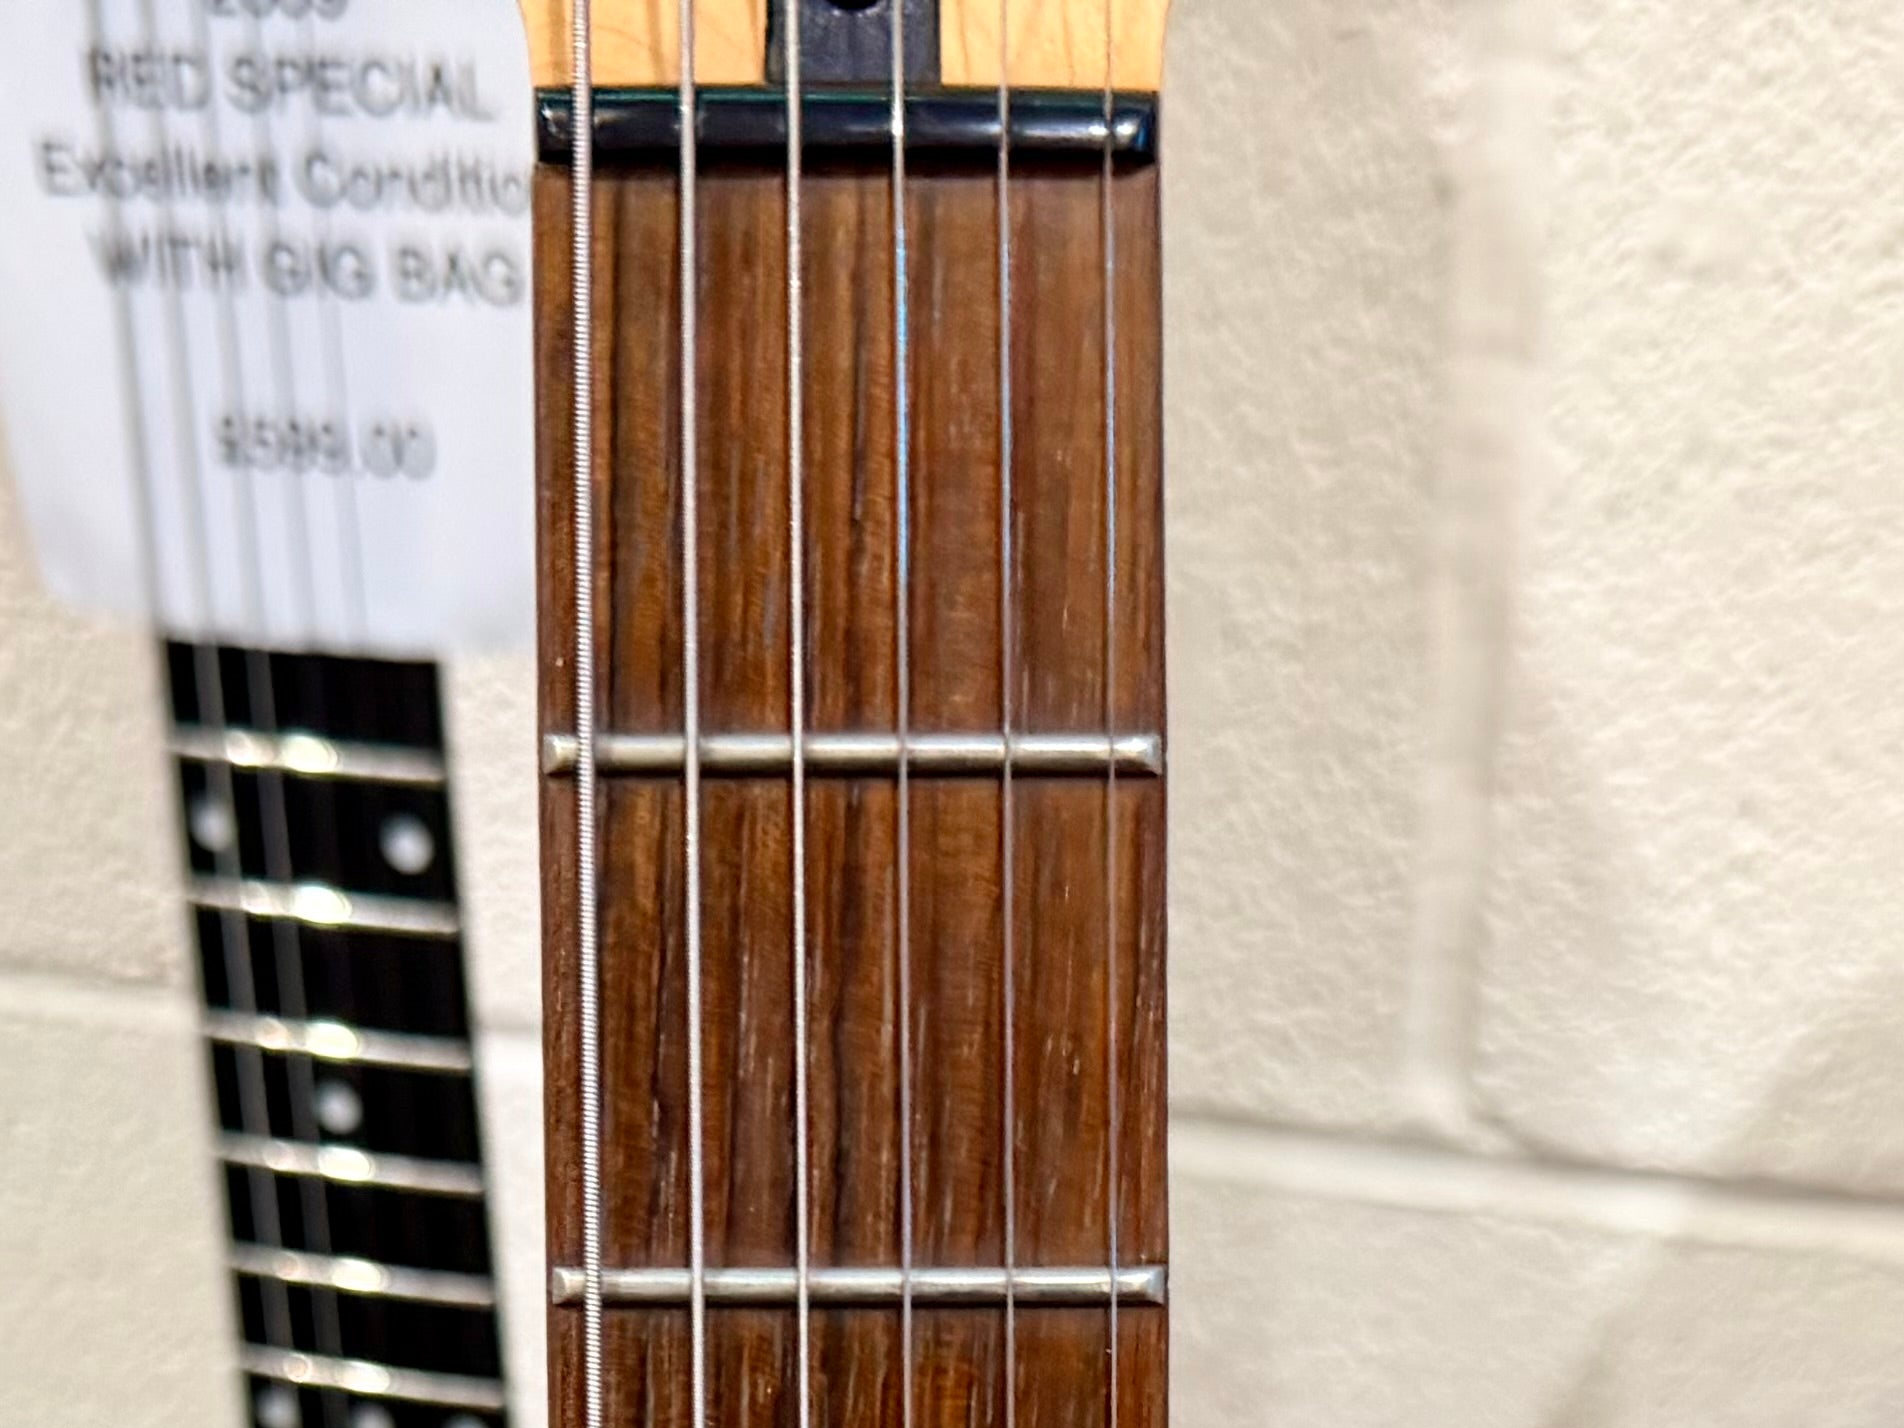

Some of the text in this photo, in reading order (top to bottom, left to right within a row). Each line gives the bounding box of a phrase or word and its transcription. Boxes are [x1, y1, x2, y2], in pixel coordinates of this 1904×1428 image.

[86, 48, 492, 120] RED SPECIAL
[299, 148, 533, 214] Conditio
